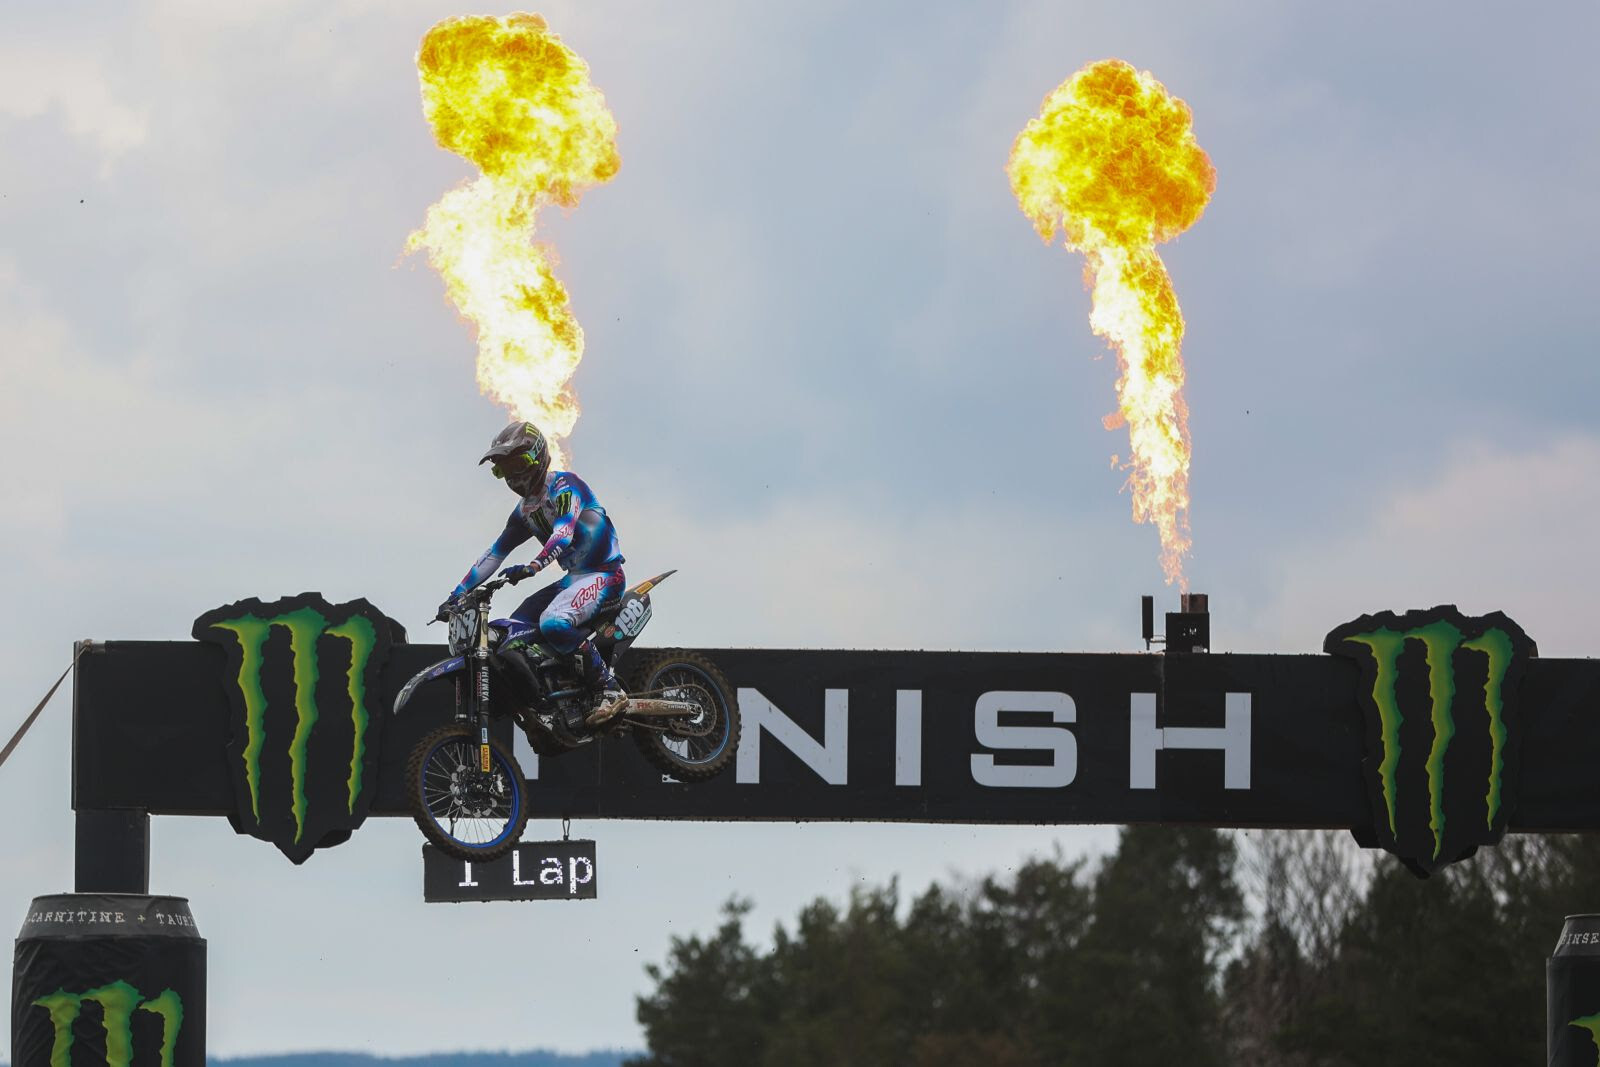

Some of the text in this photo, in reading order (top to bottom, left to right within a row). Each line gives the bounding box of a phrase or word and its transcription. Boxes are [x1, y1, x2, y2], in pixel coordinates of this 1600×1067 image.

[614, 598, 645, 637] 198
[481, 666, 489, 701] YAMAHA
[512, 686, 1252, 790] NISH
[512, 849, 593, 894] Lap
